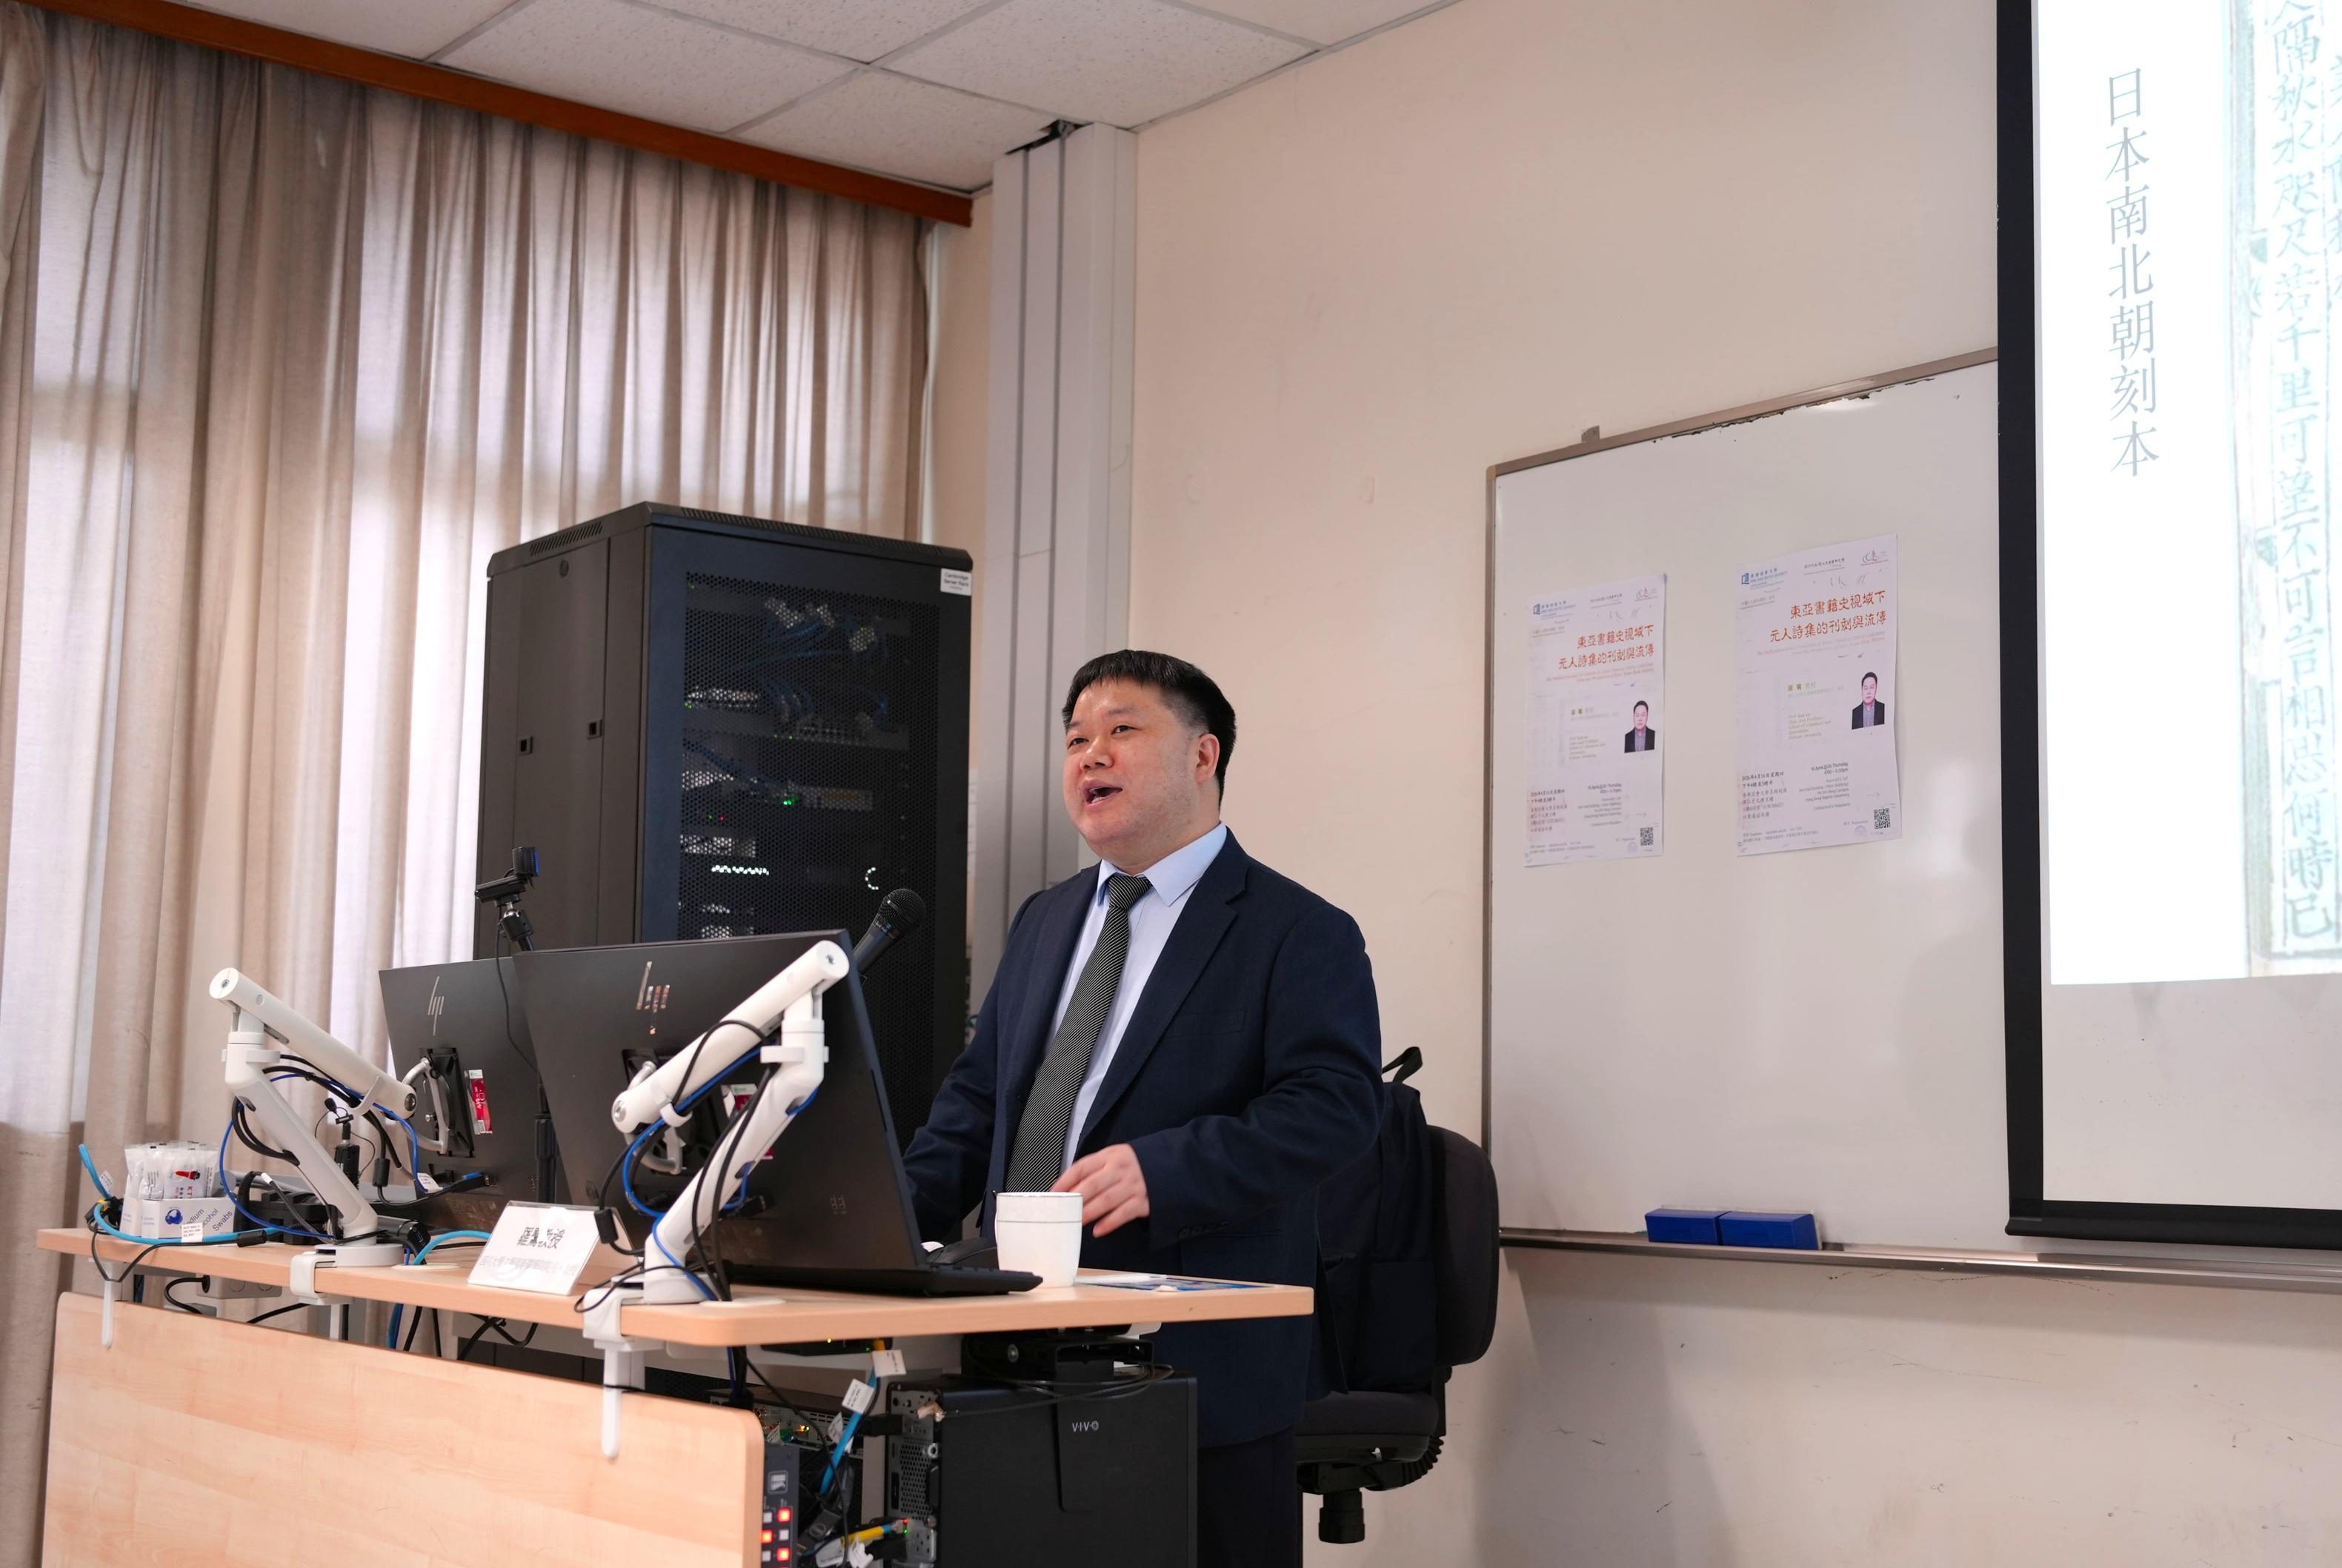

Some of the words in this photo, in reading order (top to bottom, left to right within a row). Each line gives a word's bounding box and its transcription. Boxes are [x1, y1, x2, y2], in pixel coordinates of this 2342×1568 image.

[2104, 67, 2160, 478] 日本南北朝刻本
[1791, 590, 1886, 619] 東亞書籍史視域下
[1577, 624, 1654, 649] 東亞書籍史視域下
[1770, 610, 1886, 642] 元人詩集的刊刻與流傳
[213, 1210, 233, 1231] Swabs
